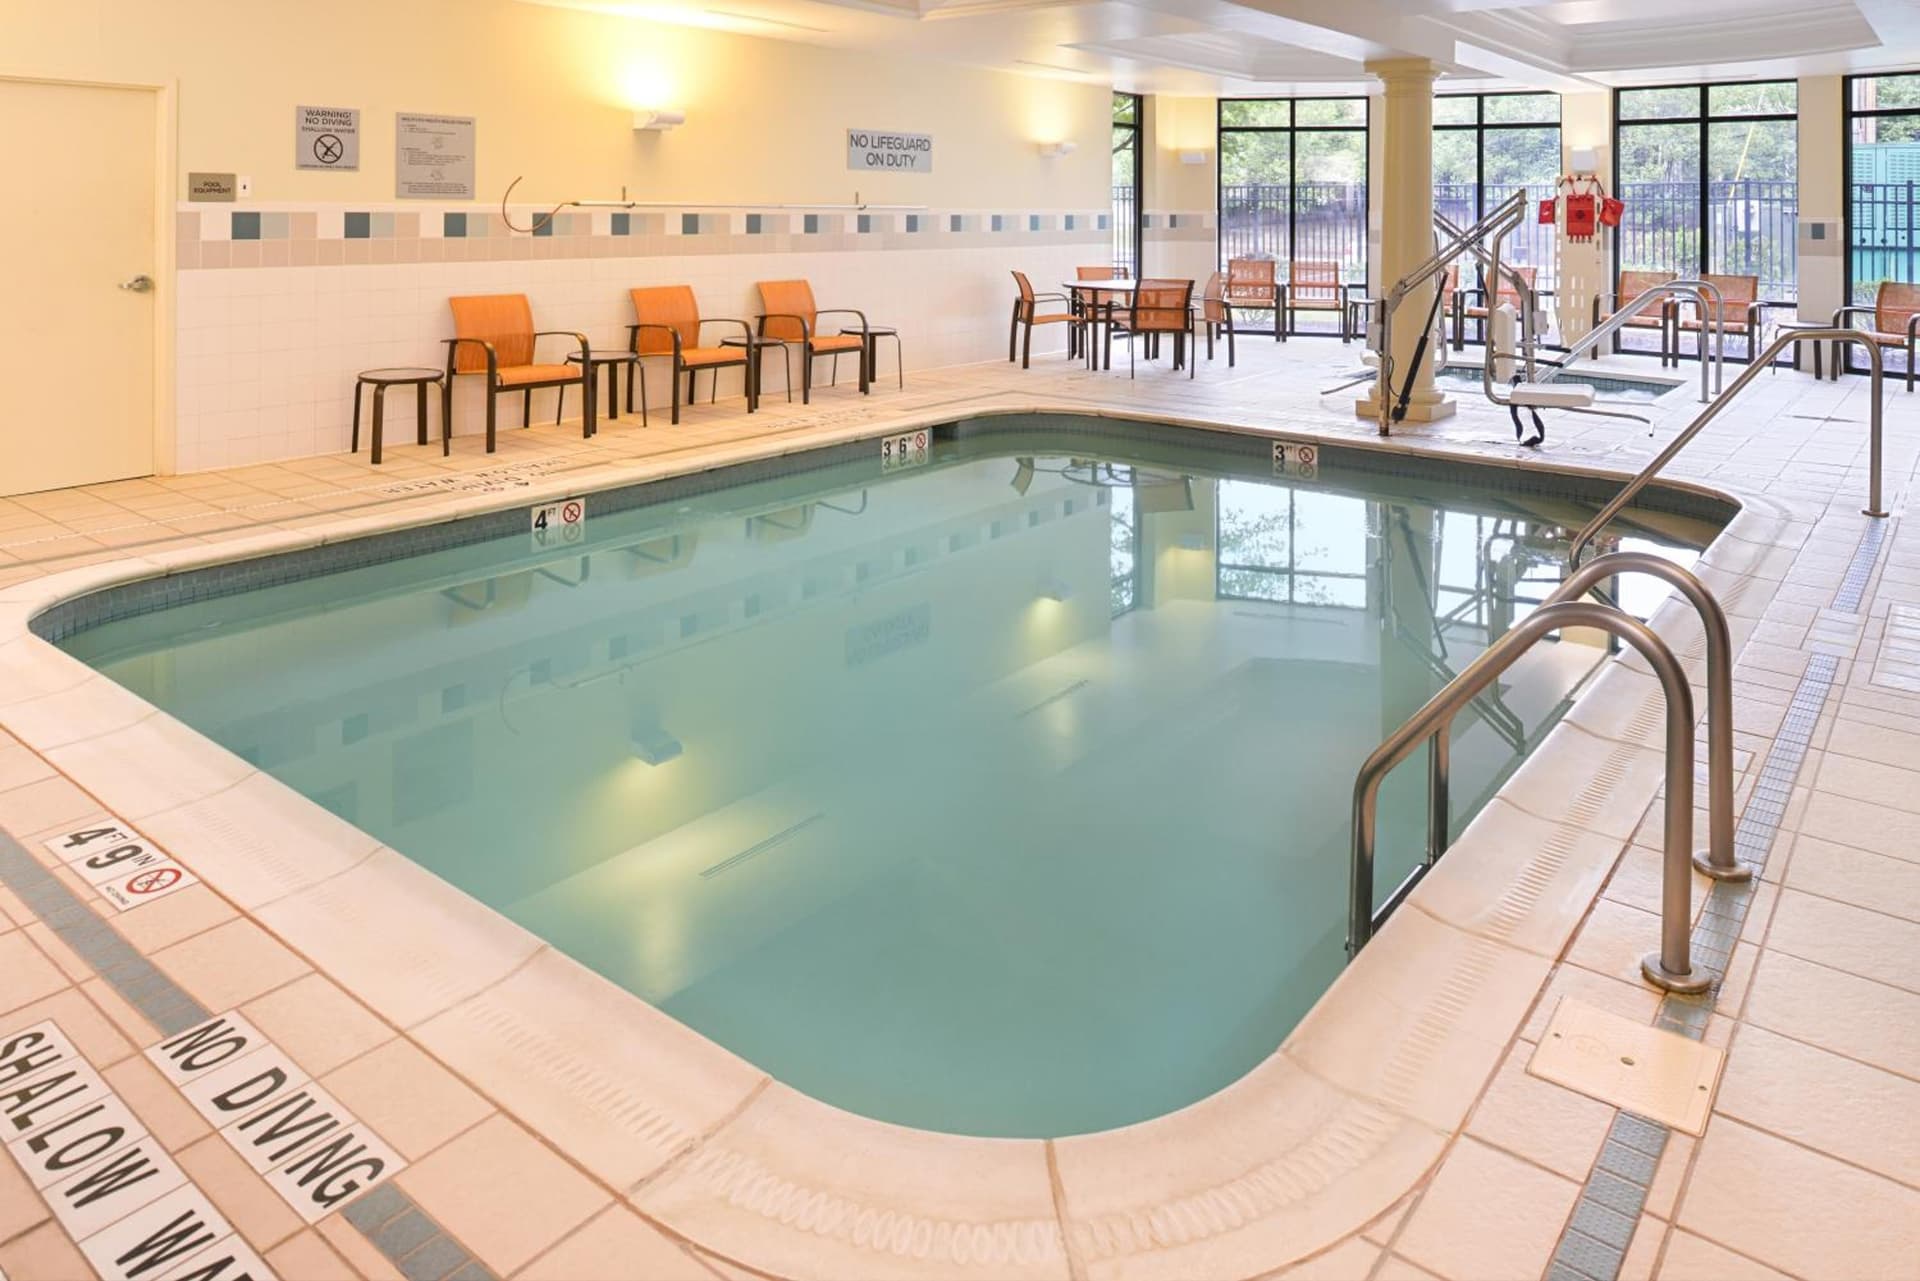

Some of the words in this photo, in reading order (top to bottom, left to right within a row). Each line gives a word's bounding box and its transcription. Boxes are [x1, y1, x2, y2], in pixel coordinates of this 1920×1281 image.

[305, 110, 352, 118] WARNING!
[305, 117, 320, 125] NO
[322, 118, 352, 126] DIVING
[850, 134, 868, 148] NO
[871, 136, 932, 151] LIFEGUARD
[866, 152, 884, 166] ON
[886, 154, 916, 168] DUTY
[884, 441, 891, 456] 3
[1275, 445, 1284, 460] 3
[535, 510, 547, 529] 4
[63, 827, 117, 848] 4
[86, 844, 143, 869] 9
[160, 1018, 247, 1071] NO
[211, 1066, 385, 1209] DIVING
[0, 1032, 159, 1209] SHALLOW
[115, 1209, 254, 1281] WA
